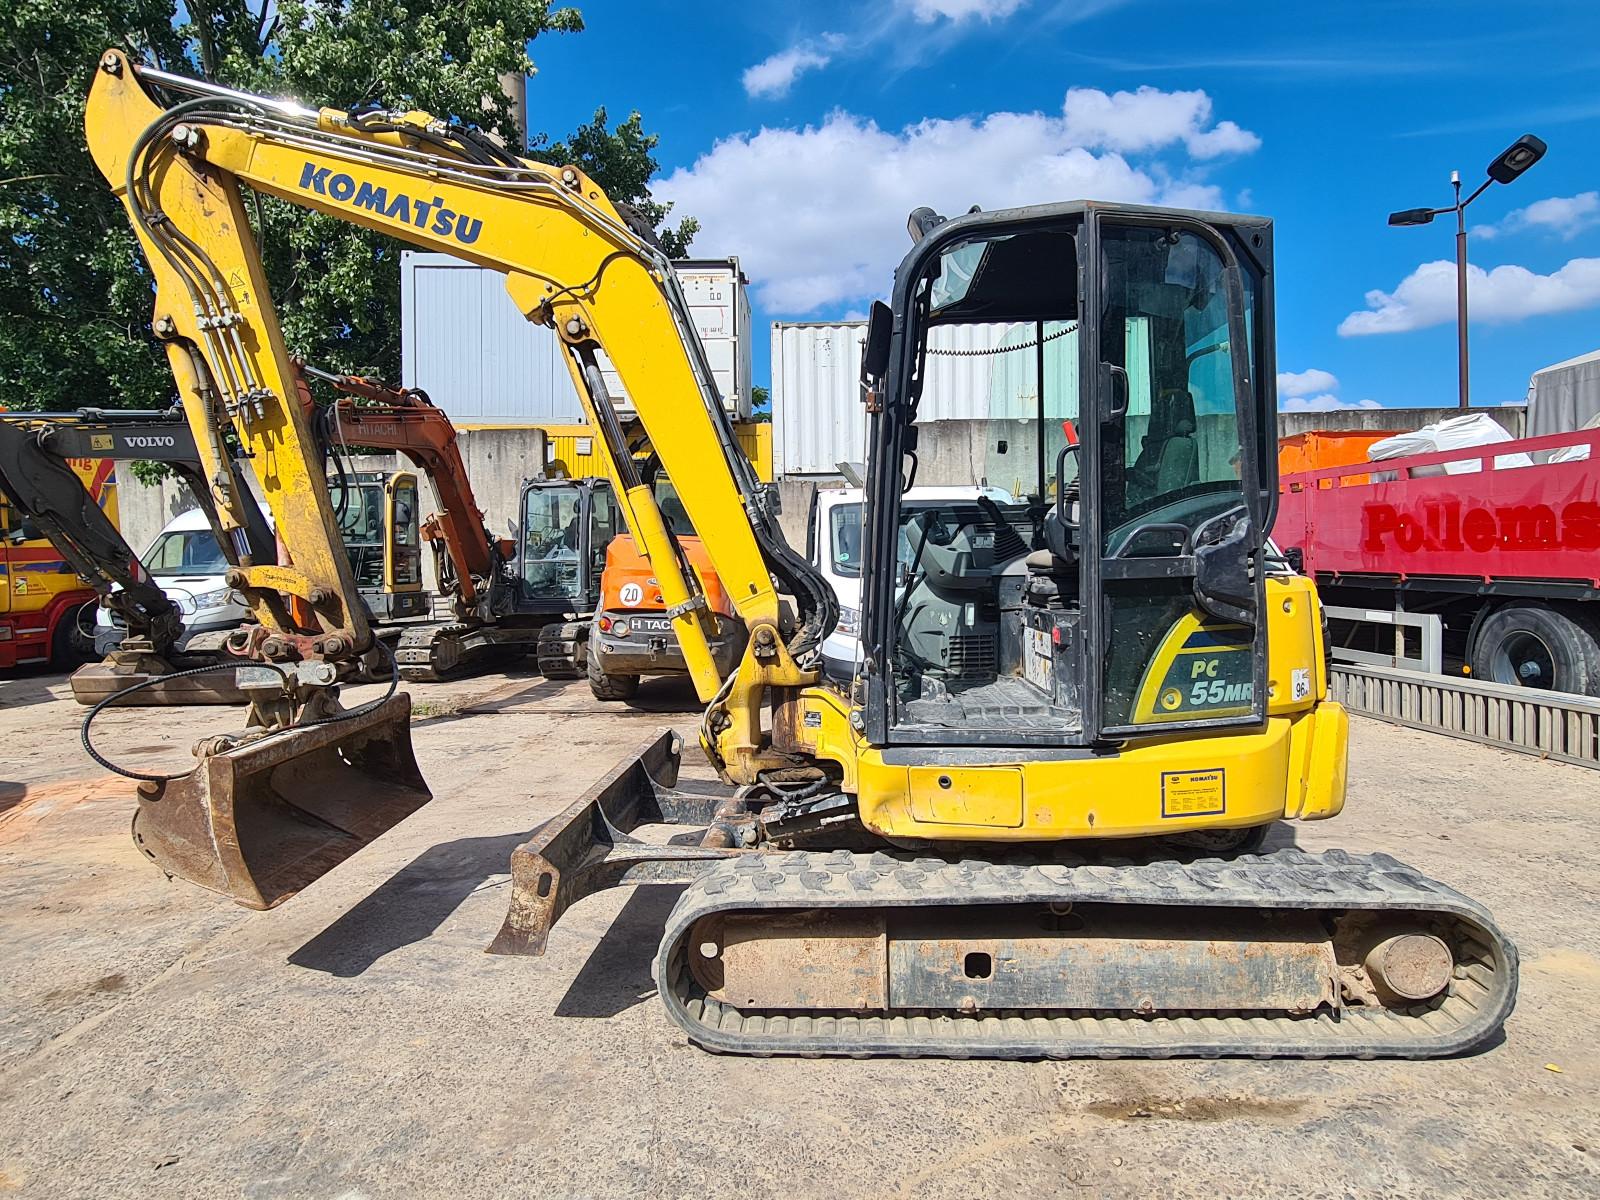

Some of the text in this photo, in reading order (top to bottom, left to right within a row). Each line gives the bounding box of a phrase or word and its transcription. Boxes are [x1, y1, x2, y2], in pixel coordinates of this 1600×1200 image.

[299, 162, 483, 244] KOMATSU
[359, 423, 397, 436] HITACHI
[124, 436, 175, 447] VOLVO
[624, 588, 638, 602] 20
[1191, 659, 1219, 679] PC
[1296, 682, 1305, 698] 96
